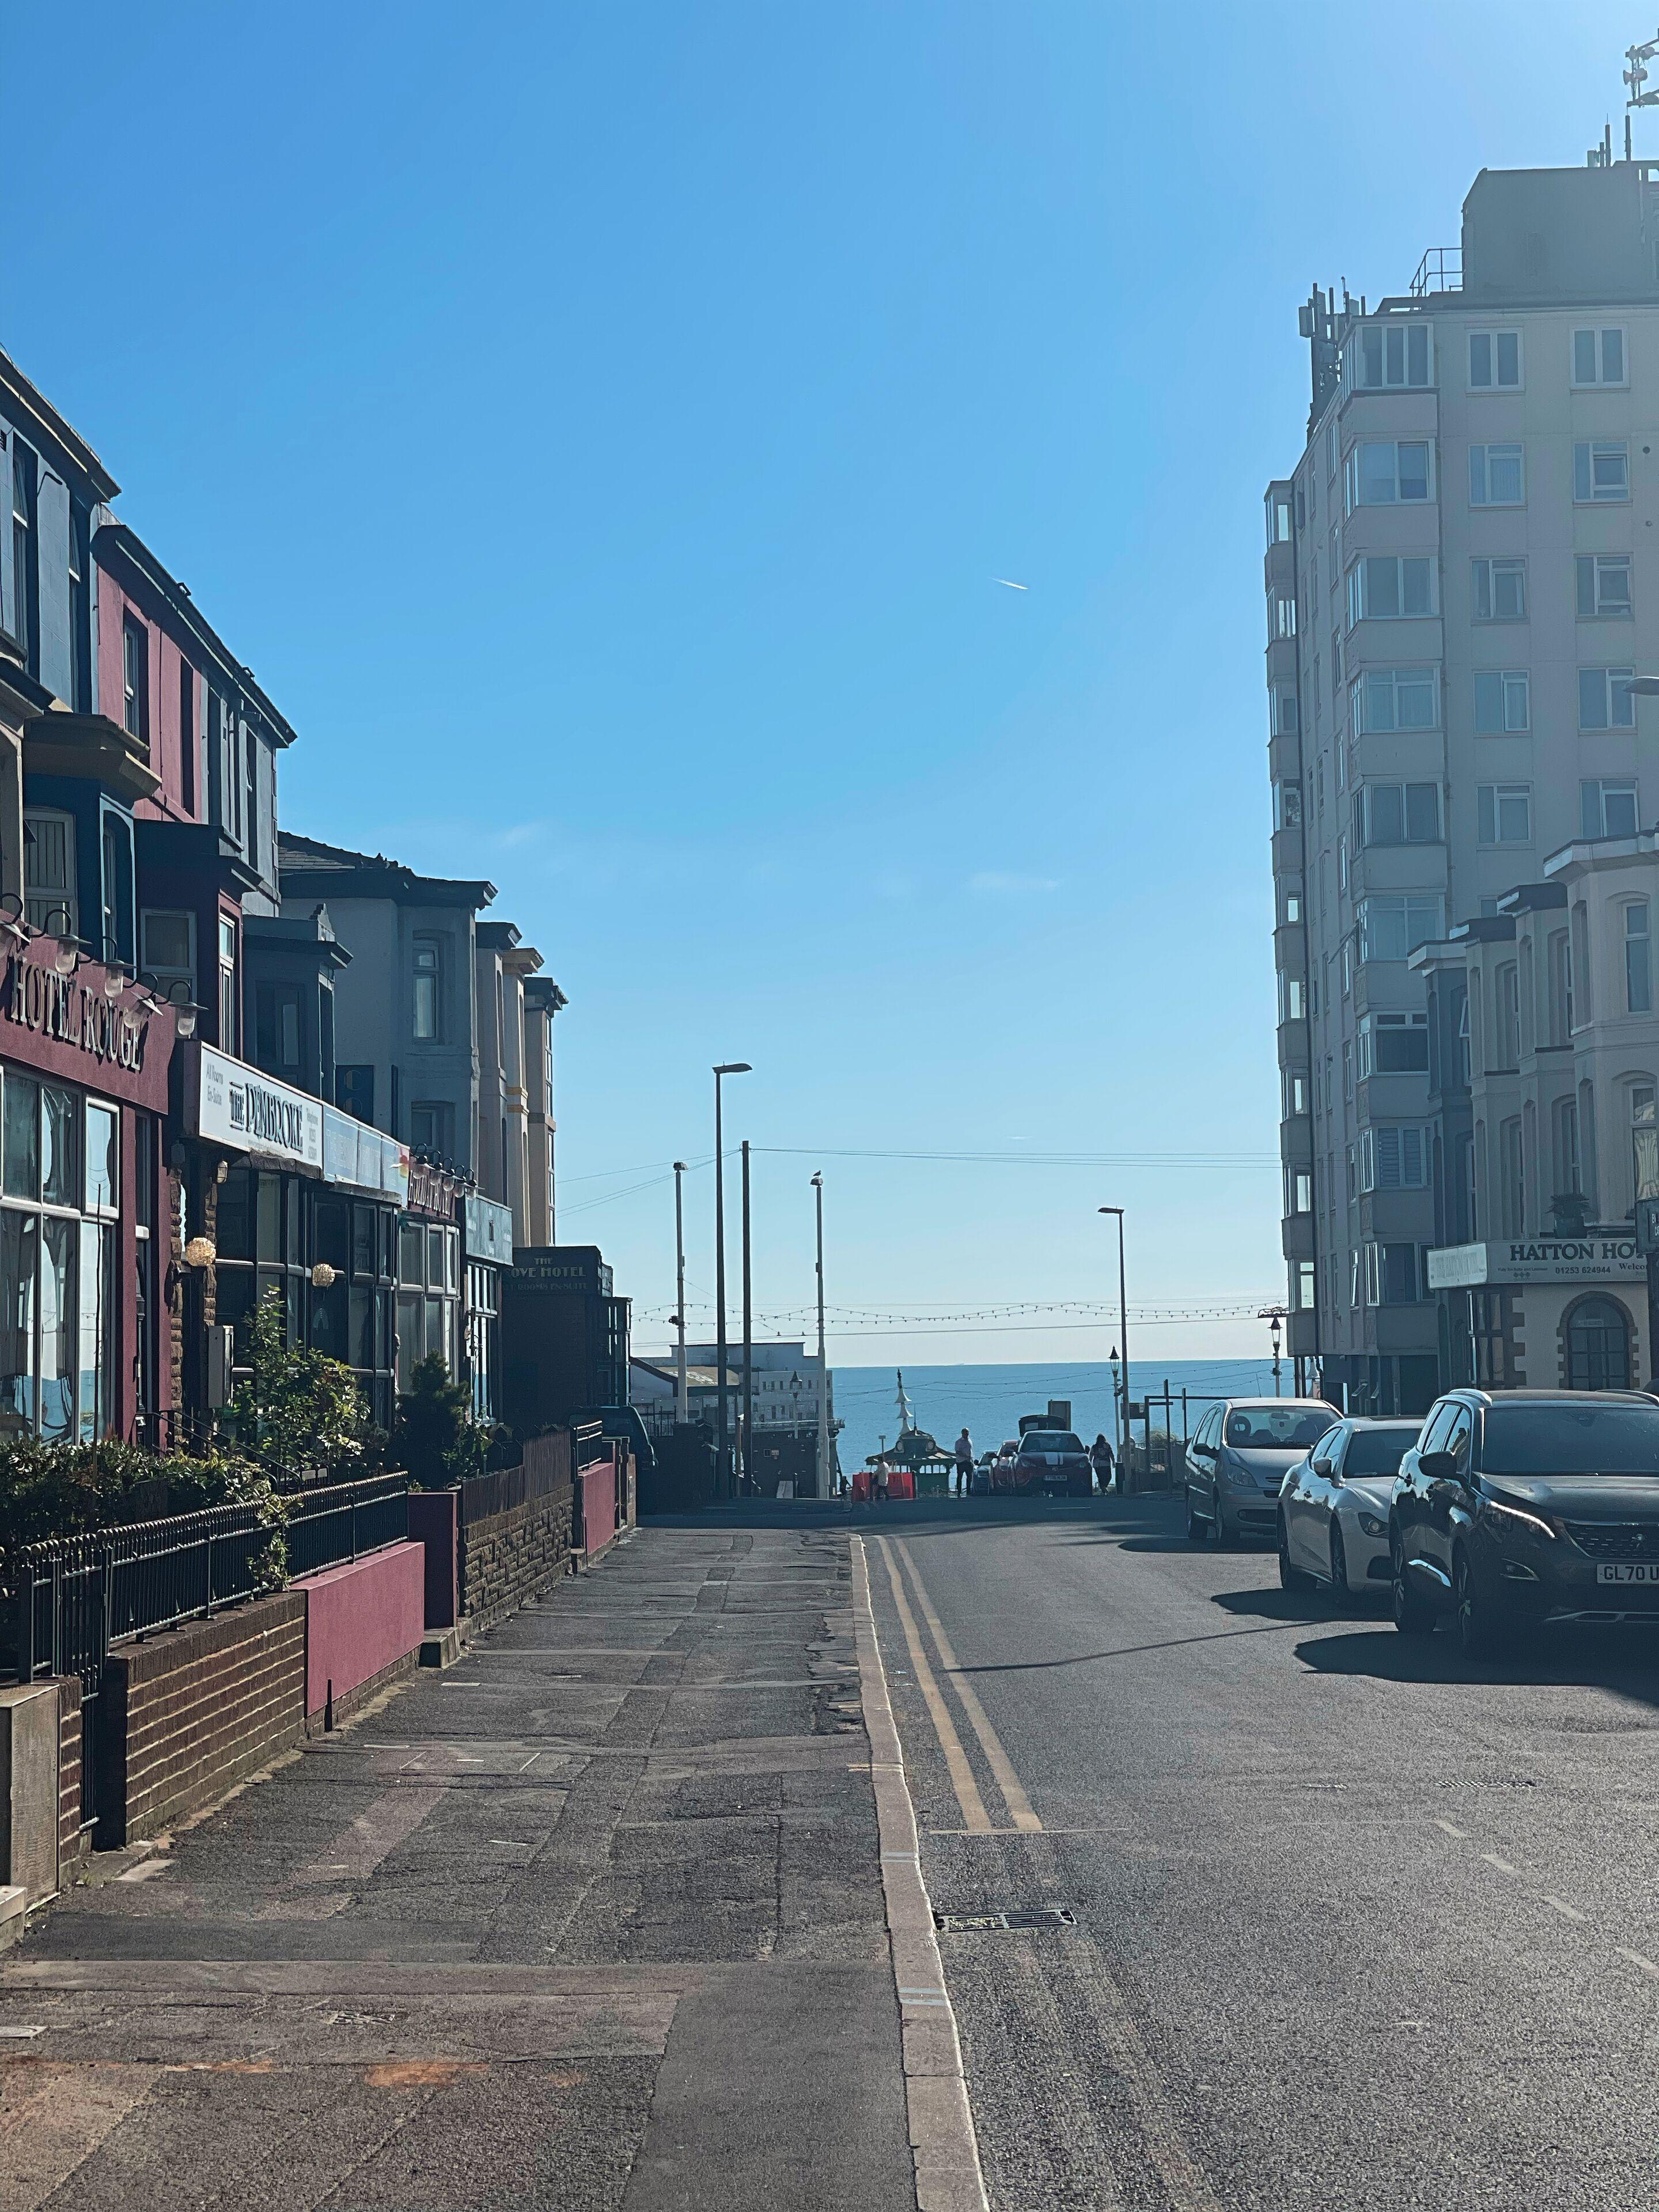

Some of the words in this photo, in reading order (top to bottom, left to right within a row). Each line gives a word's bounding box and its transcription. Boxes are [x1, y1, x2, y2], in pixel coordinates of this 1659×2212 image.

[11, 953, 82, 1044] HOTEL
[85, 986, 144, 1071] ROUGE
[230, 1089, 244, 1126] THE
[245, 1082, 304, 1154] PEMBROKE
[1510, 1243, 1594, 1261] HATTON
[533, 1257, 554, 1266] THE
[504, 1267, 536, 1278] OVE
[540, 1267, 586, 1278] HOTEL
[1604, 1566, 1645, 1581] GL70
